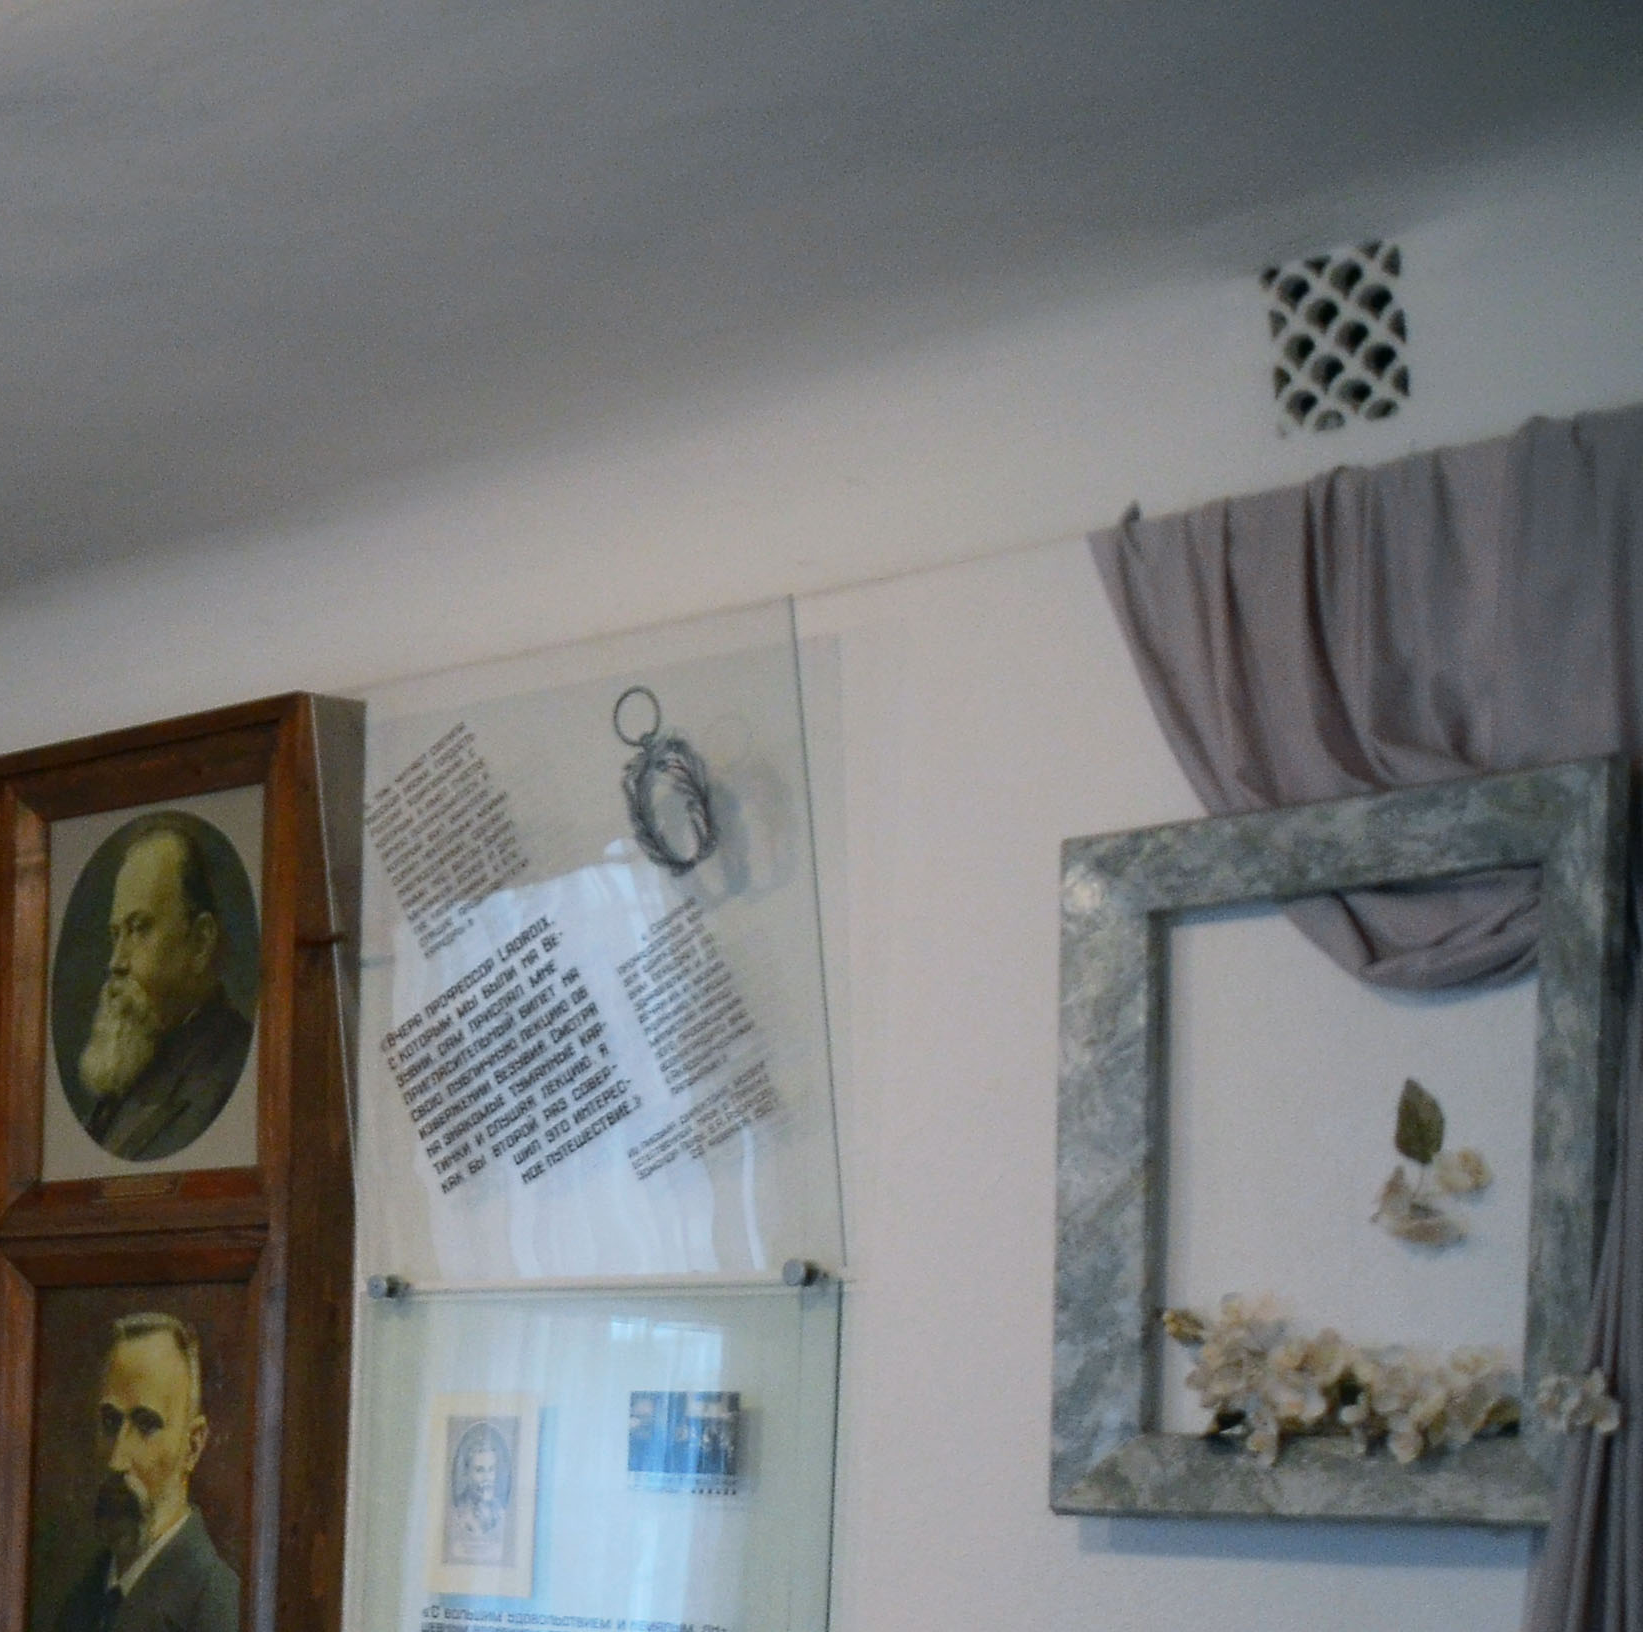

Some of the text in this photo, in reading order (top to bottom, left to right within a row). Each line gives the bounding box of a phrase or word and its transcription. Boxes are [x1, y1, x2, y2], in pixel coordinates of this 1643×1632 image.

[399, 1014, 453, 1062] КОТОРЫМ
[455, 996, 479, 1020] МЫ
[481, 966, 517, 1000] БЫЛИ
[521, 948, 539, 968] НА
[425, 958, 495, 1018] ПРОФЕССОР
[437, 1030, 465, 1058] САМ
[467, 984, 525, 1034] ПРИСЛАЛ
[529, 960, 557, 988] МНЕ
[517, 984, 555, 1020] БИЛЕТ
[561, 968, 579, 988] НА
[409, 1092, 443, 1124] СВОЮ
[519, 1000, 569, 1044] ЛЕКЦИЮ
[571, 986, 589, 1006] ОБ
[425, 1140, 443, 1158] НА
[443, 1094, 507, 1146] ЗНАКОМЫЕ
[509, 1042, 575, 1098] ТУМАННЫЕ
[475, 1132, 485, 1146] И
[485, 1094, 537, 1138] СЛУШАЯ
[597, 1042, 609, 1058] Я
[419, 1080, 493, 1140] ИЗВЕРЖЕНИИ
[441, 1172, 465, 1194] КАК
[467, 1154, 487, 1176] БЫ
[491, 1118, 539, 1158] ВТОРОЙ
[543, 1098, 569, 1122] РАЗ
[513, 1138, 541, 1166] ШИЛ
[545, 1118, 571, 1144] ЭТО
[521, 1162, 545, 1184] НОЕ
